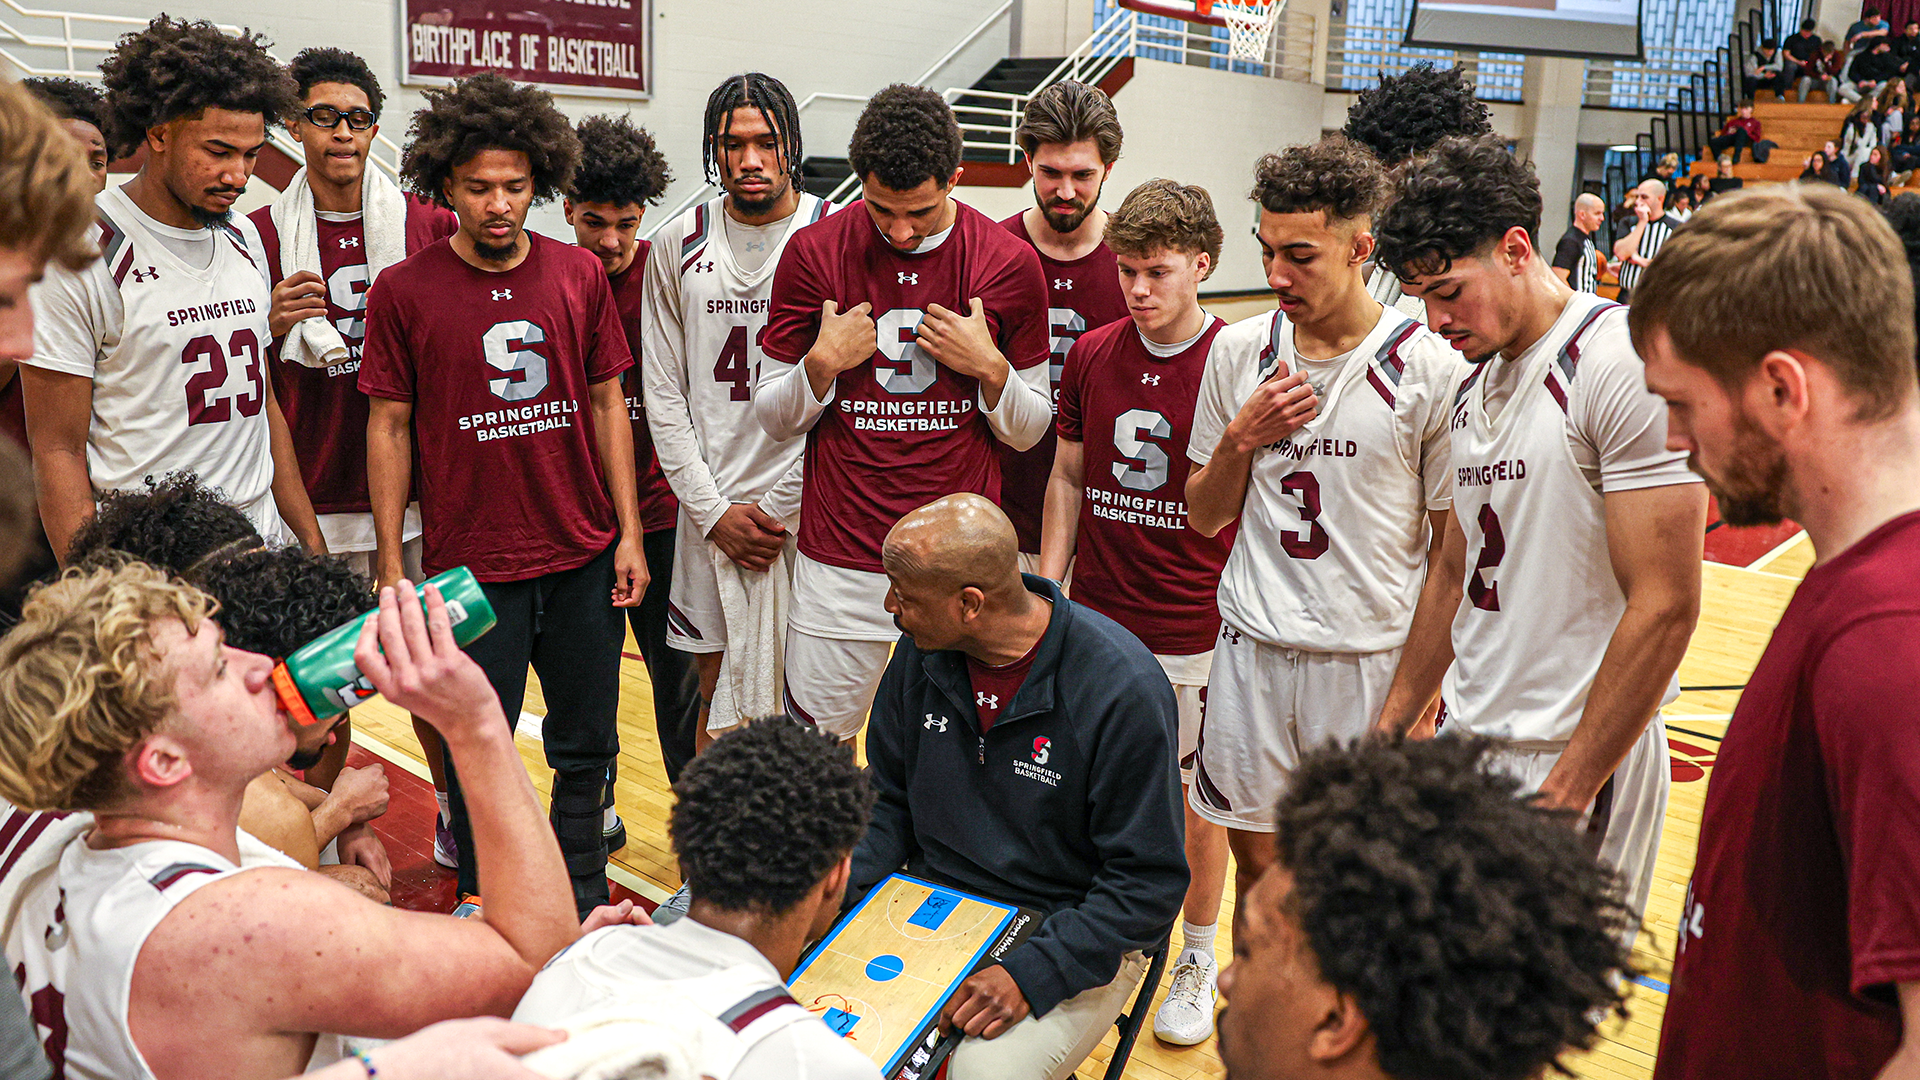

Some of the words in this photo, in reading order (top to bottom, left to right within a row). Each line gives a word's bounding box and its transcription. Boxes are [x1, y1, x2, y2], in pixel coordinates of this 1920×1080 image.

[411, 23, 513, 69] BIRTHPLACE
[519, 33, 541, 71] OF
[547, 36, 640, 80] BASKETBALL
[167, 298, 256, 327] SPRINGFIELD
[706, 299, 770, 314] SPRINGFI
[481, 318, 550, 403] S
[181, 327, 264, 427] 23
[458, 400, 579, 431] SPRINGFIELD
[840, 399, 972, 416] SPRINGFIELD
[476, 415, 572, 443] BASKETBALL
[854, 416, 959, 432] BASKETBALL
[1110, 407, 1173, 493] S
[1262, 438, 1358, 461] PRINFIELD
[1085, 486, 1189, 516] SPRINGFIEL
[1093, 504, 1186, 530] BASKETBALL
[1279, 470, 1330, 561] 3
[1467, 502, 1507, 612] 2
[1012, 759, 1062, 780] SPRINGFIELD
[1014, 766, 1058, 787] BASKETBALL
[1009, 914, 1031, 937] Sport
